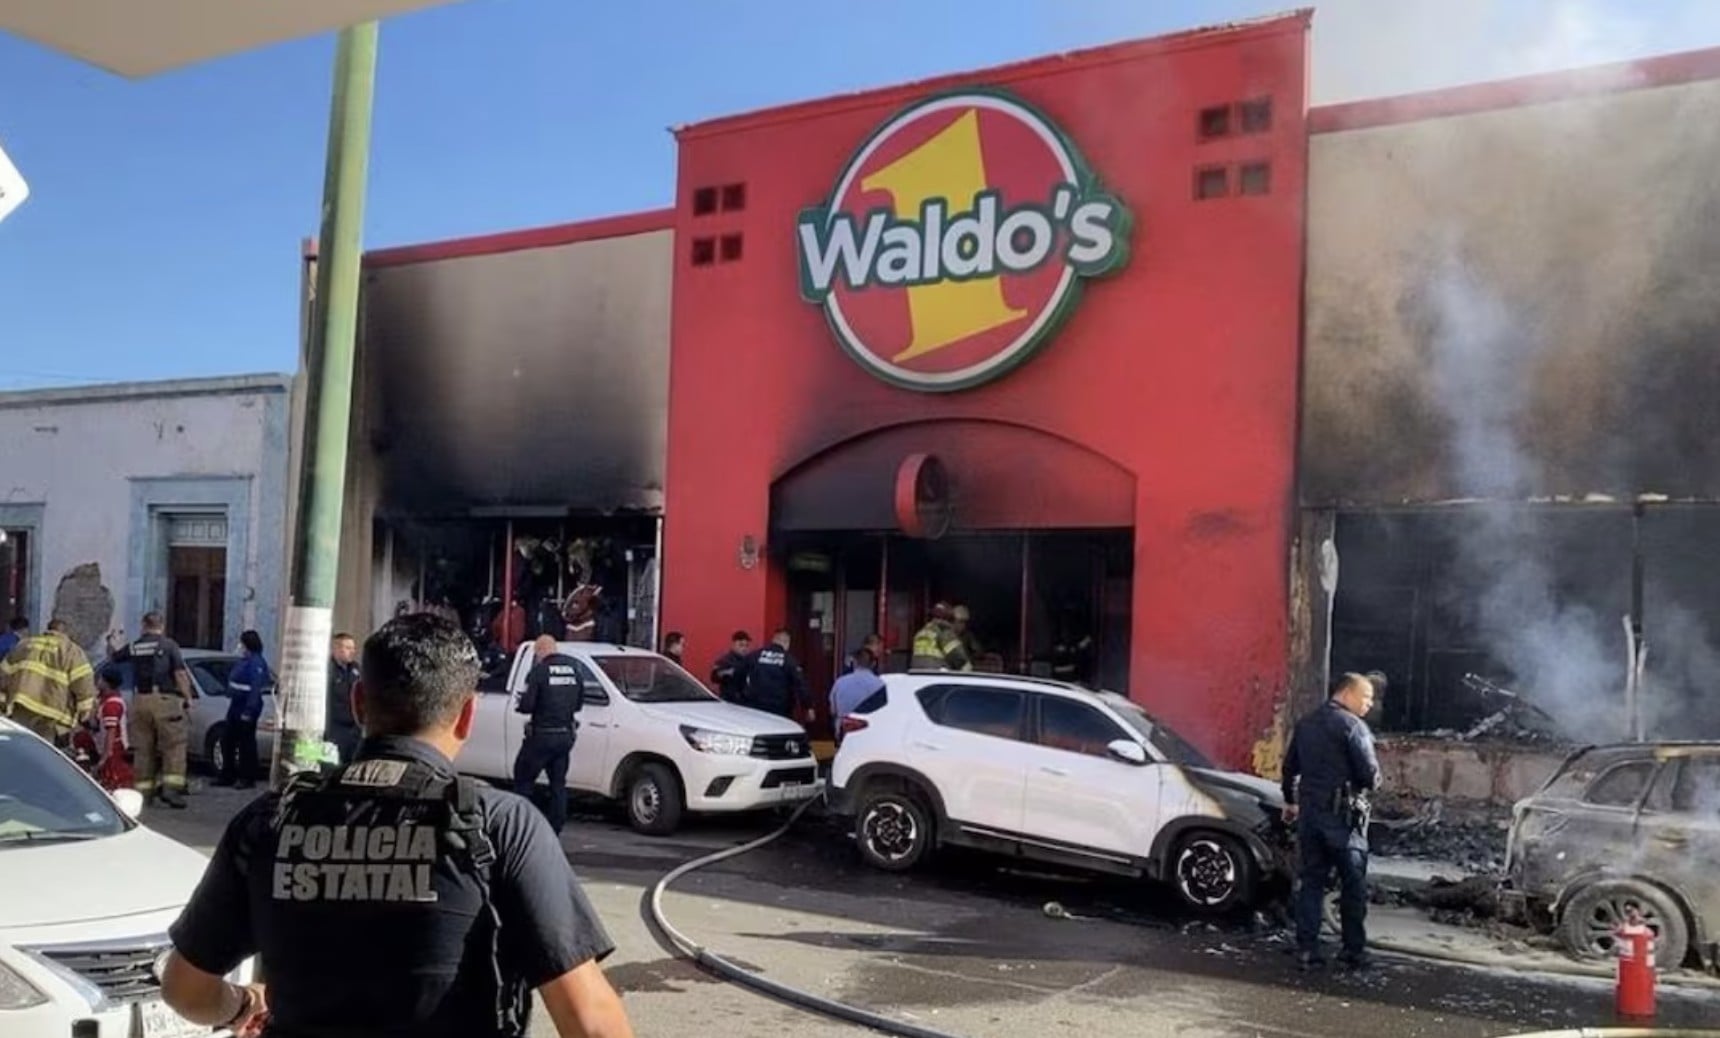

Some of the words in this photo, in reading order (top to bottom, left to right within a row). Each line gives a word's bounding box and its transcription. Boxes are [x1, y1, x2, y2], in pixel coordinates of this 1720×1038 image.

[800, 190, 1114, 289] Waldo's
[861, 108, 1028, 362] 1
[272, 862, 438, 902] ESTATAL
